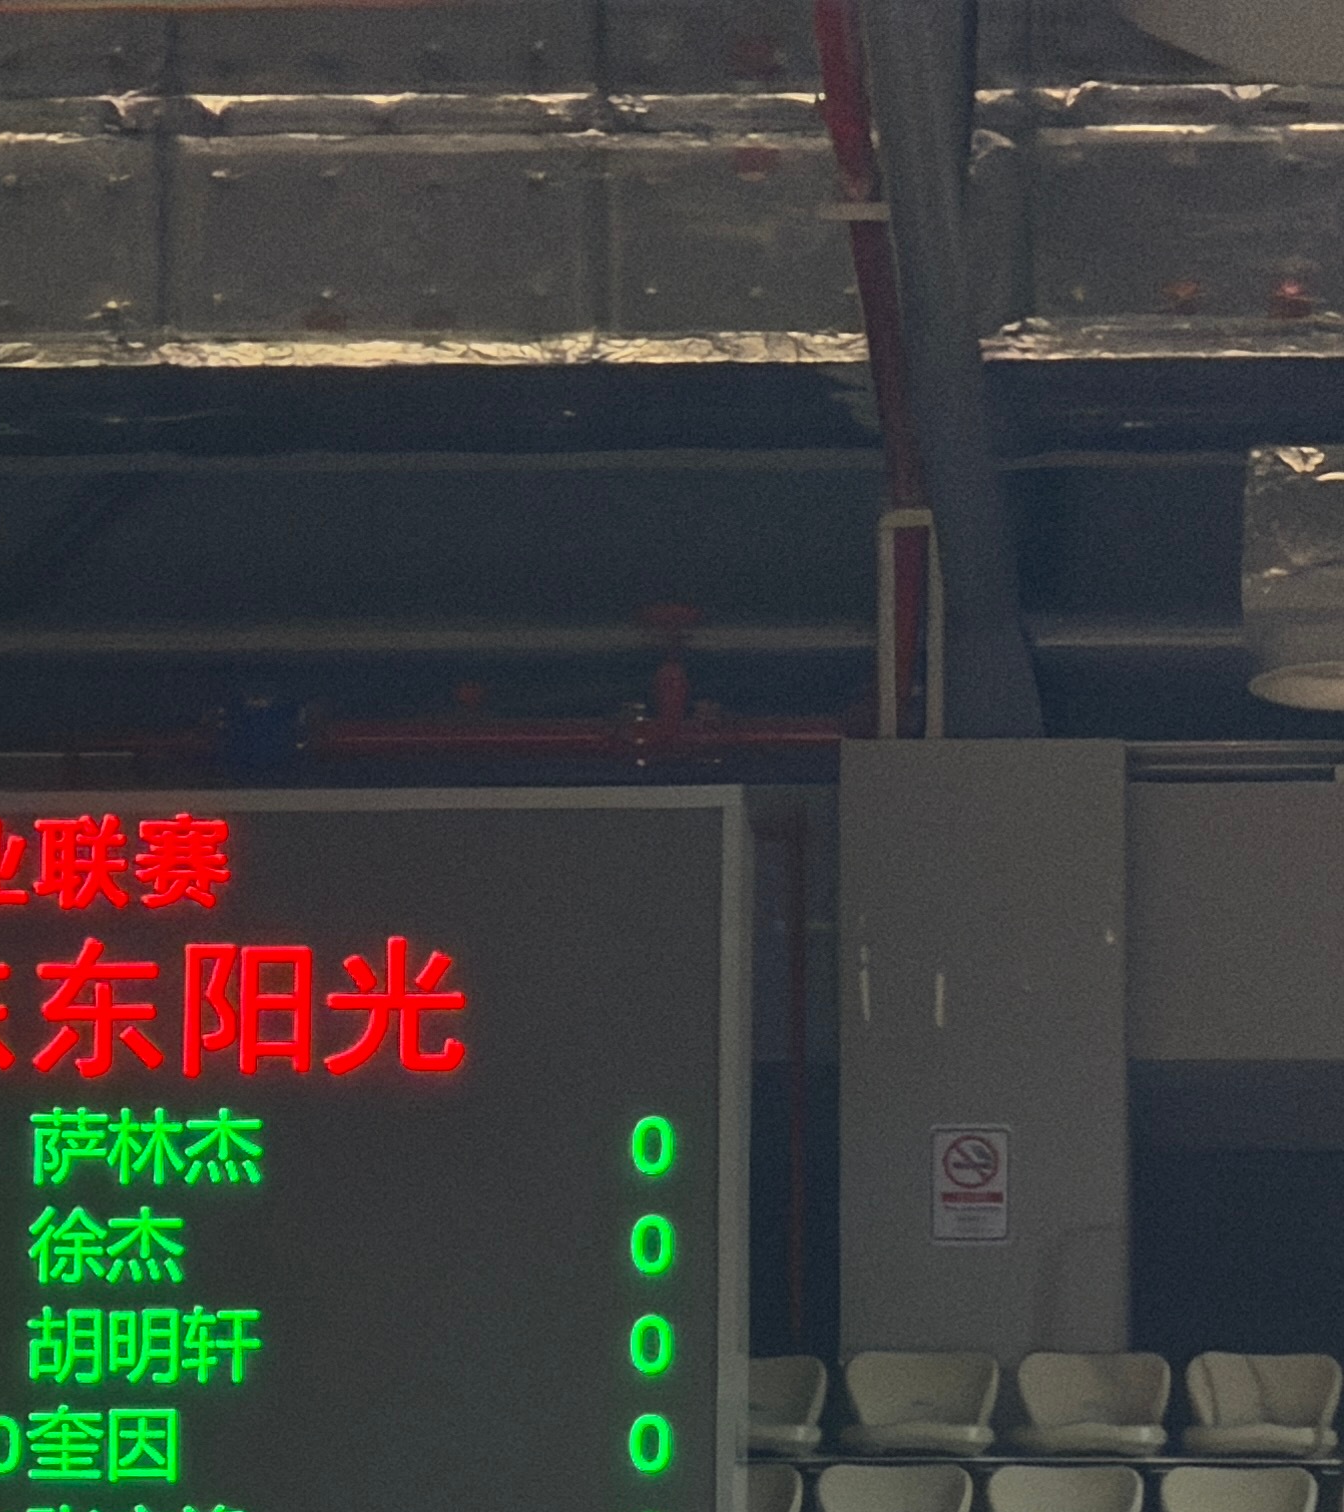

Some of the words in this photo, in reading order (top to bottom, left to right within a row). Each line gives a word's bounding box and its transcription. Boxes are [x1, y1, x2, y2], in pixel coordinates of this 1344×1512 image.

[30, 1107, 262, 1185] 萨林杰
[632, 1116, 675, 1175] 0
[28, 1206, 184, 1284] 徐杰
[631, 1214, 674, 1275] 0
[27, 1305, 261, 1384] 胡明轩
[630, 1314, 673, 1375] 0
[629, 1414, 672, 1473] 0
